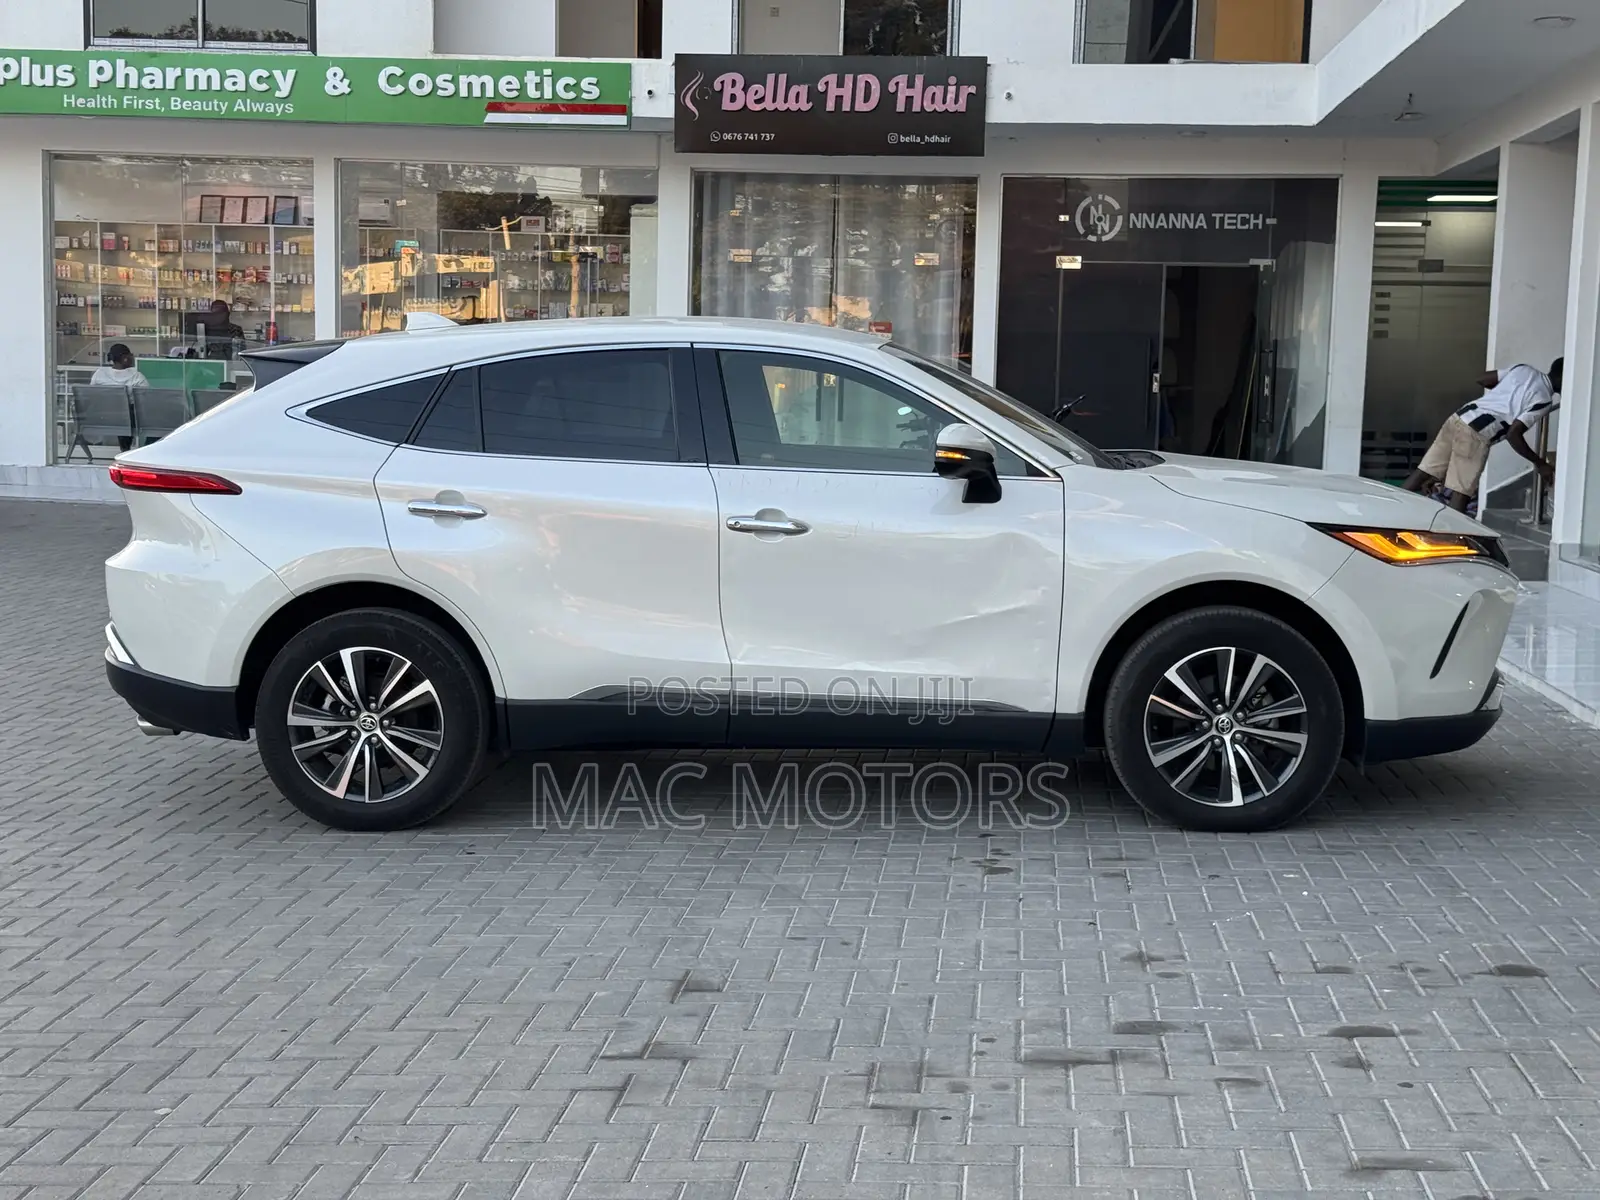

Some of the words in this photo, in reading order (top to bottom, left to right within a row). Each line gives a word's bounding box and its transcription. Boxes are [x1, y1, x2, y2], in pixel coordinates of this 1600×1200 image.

[88, 58, 297, 98] Pharmacy
[324, 66, 352, 96] &
[378, 65, 601, 100] Cosmetics
[713, 72, 814, 113] Bella
[817, 73, 881, 113] HD
[888, 74, 977, 113] Hair
[63, 94, 118, 109] Health
[123, 95, 165, 112] First,
[170, 96, 228, 115] Beauty
[233, 98, 294, 117] Always
[722, 132, 742, 141] 0676
[743, 132, 758, 141] 741
[760, 133, 775, 142] 737
[900, 134, 951, 145] bella_hdhair
[1129, 212, 1208, 229] NNANNA
[1211, 213, 1263, 230] TECH
